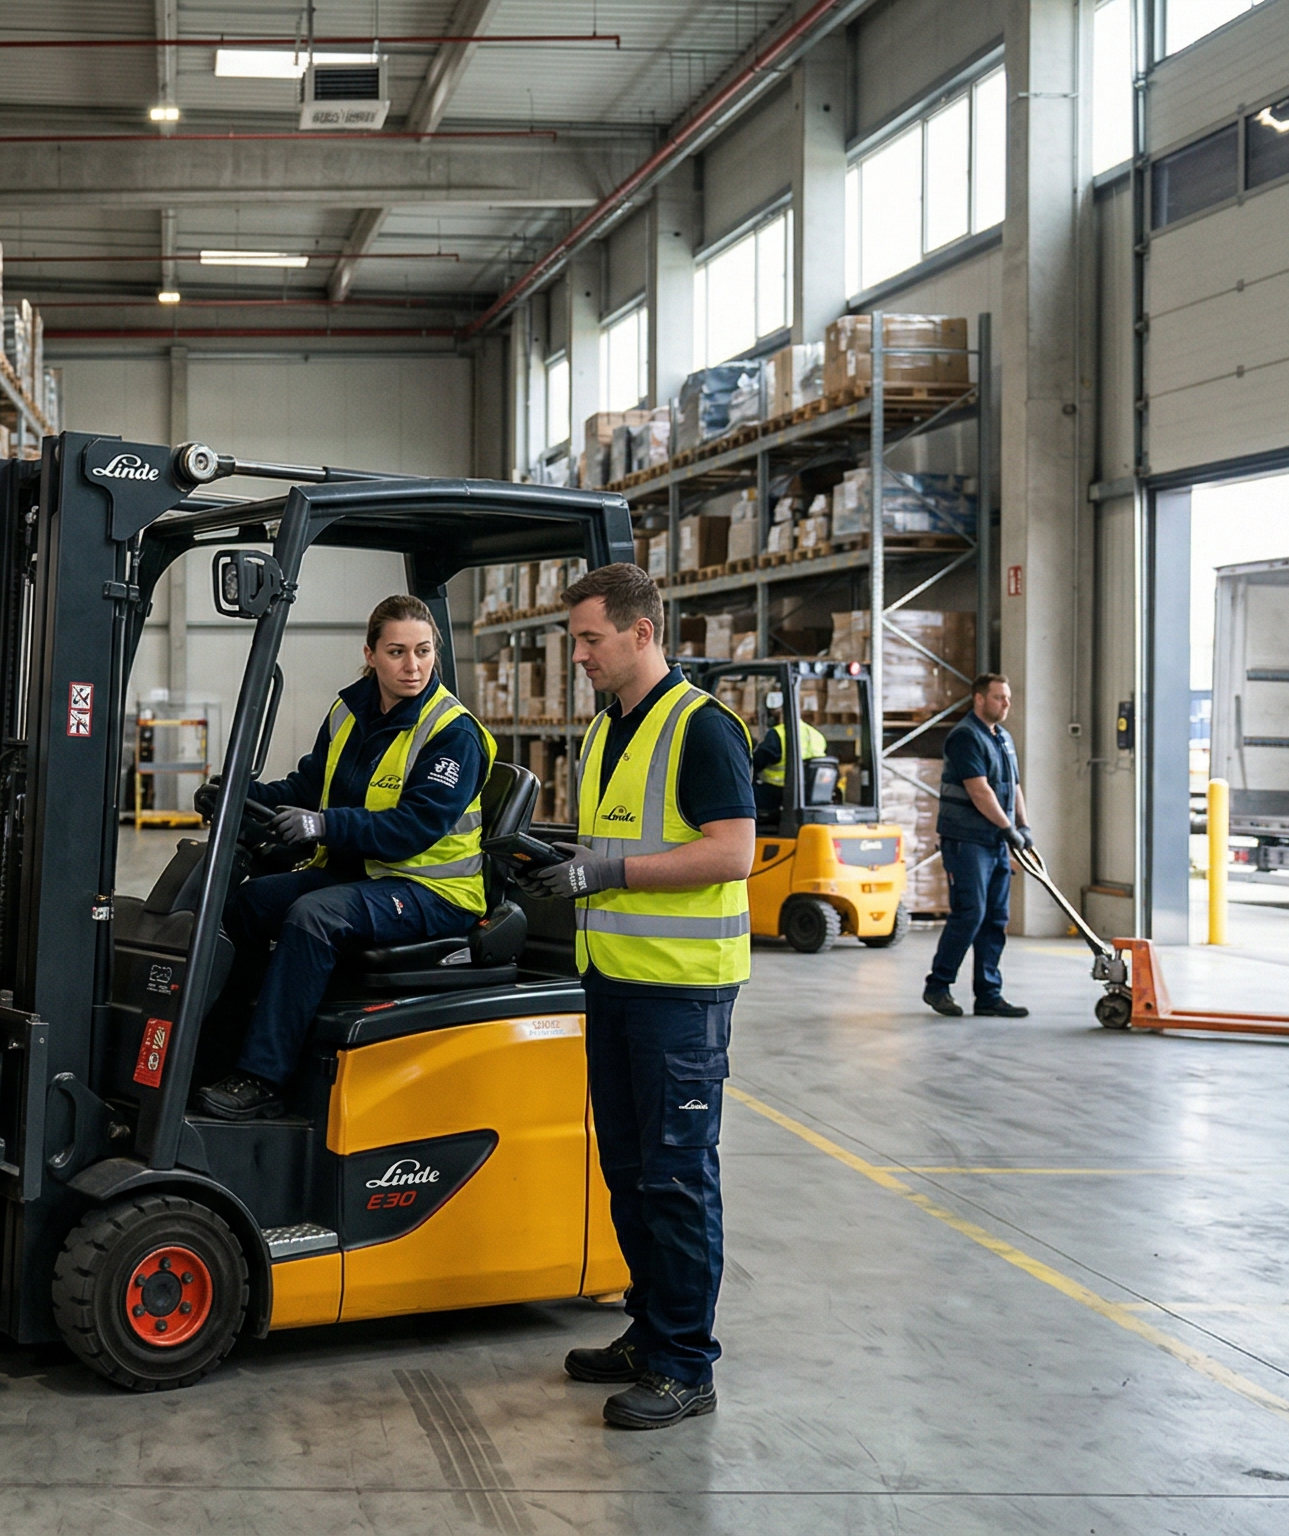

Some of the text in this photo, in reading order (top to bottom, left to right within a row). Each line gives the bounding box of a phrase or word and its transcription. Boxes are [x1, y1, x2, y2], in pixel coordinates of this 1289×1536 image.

[92, 453, 160, 481] Linde
[365, 1158, 440, 1189] Linde
[366, 1190, 417, 1210] E30
